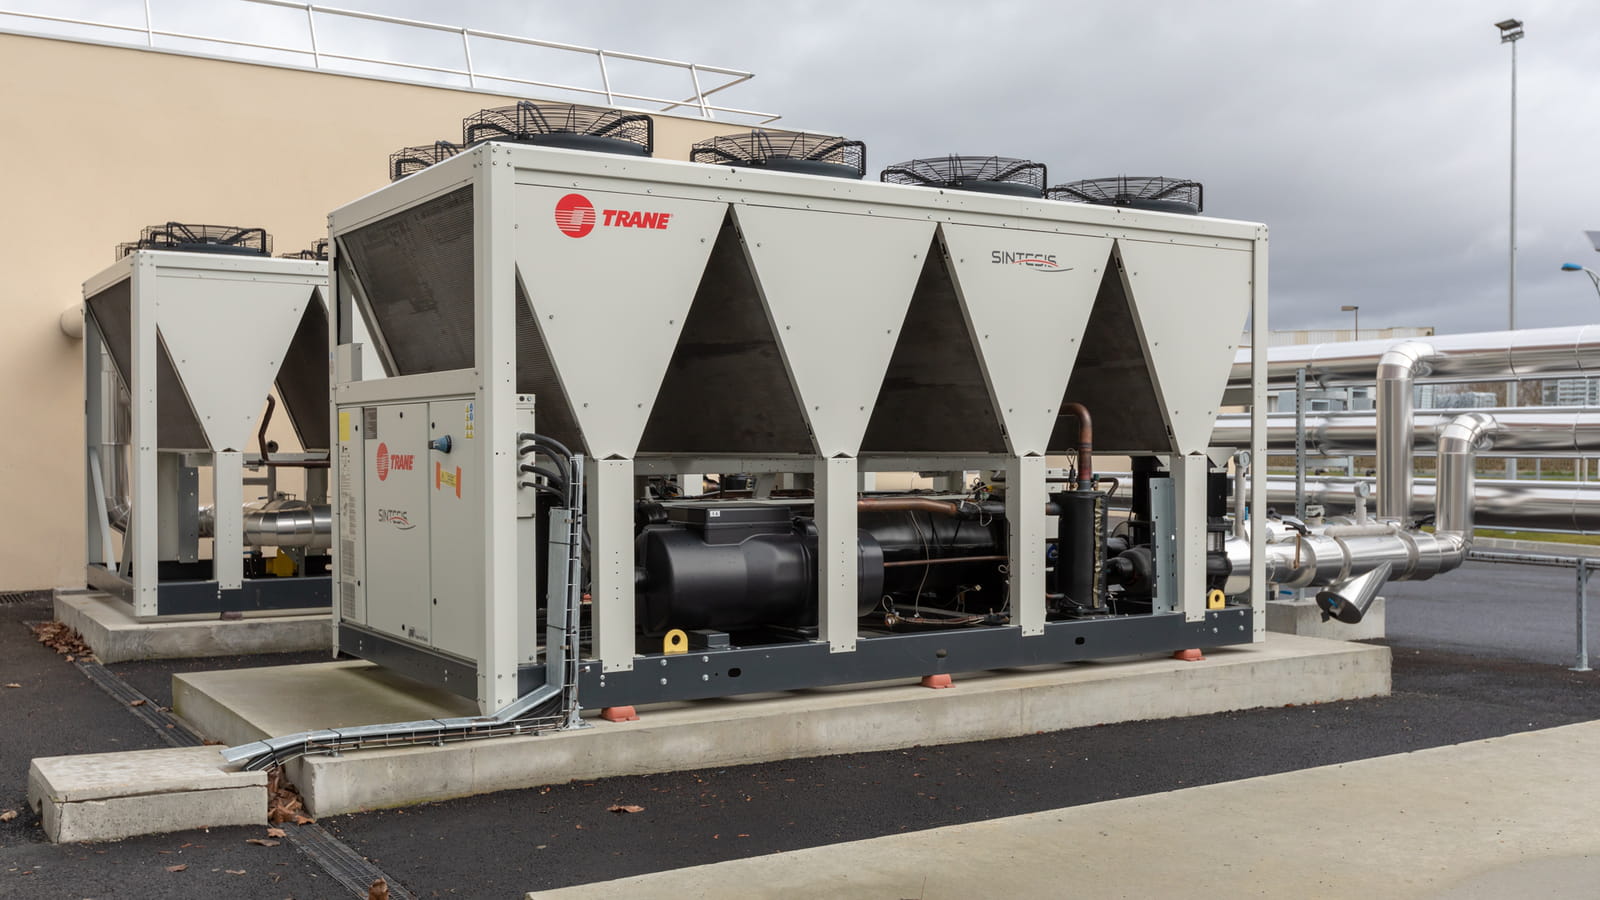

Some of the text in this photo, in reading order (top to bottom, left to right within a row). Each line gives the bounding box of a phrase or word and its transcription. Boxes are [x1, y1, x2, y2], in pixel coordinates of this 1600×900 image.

[603, 209, 670, 230] TRANE
[992, 251, 1057, 268] SINTESIS
[391, 454, 414, 471] TRANE
